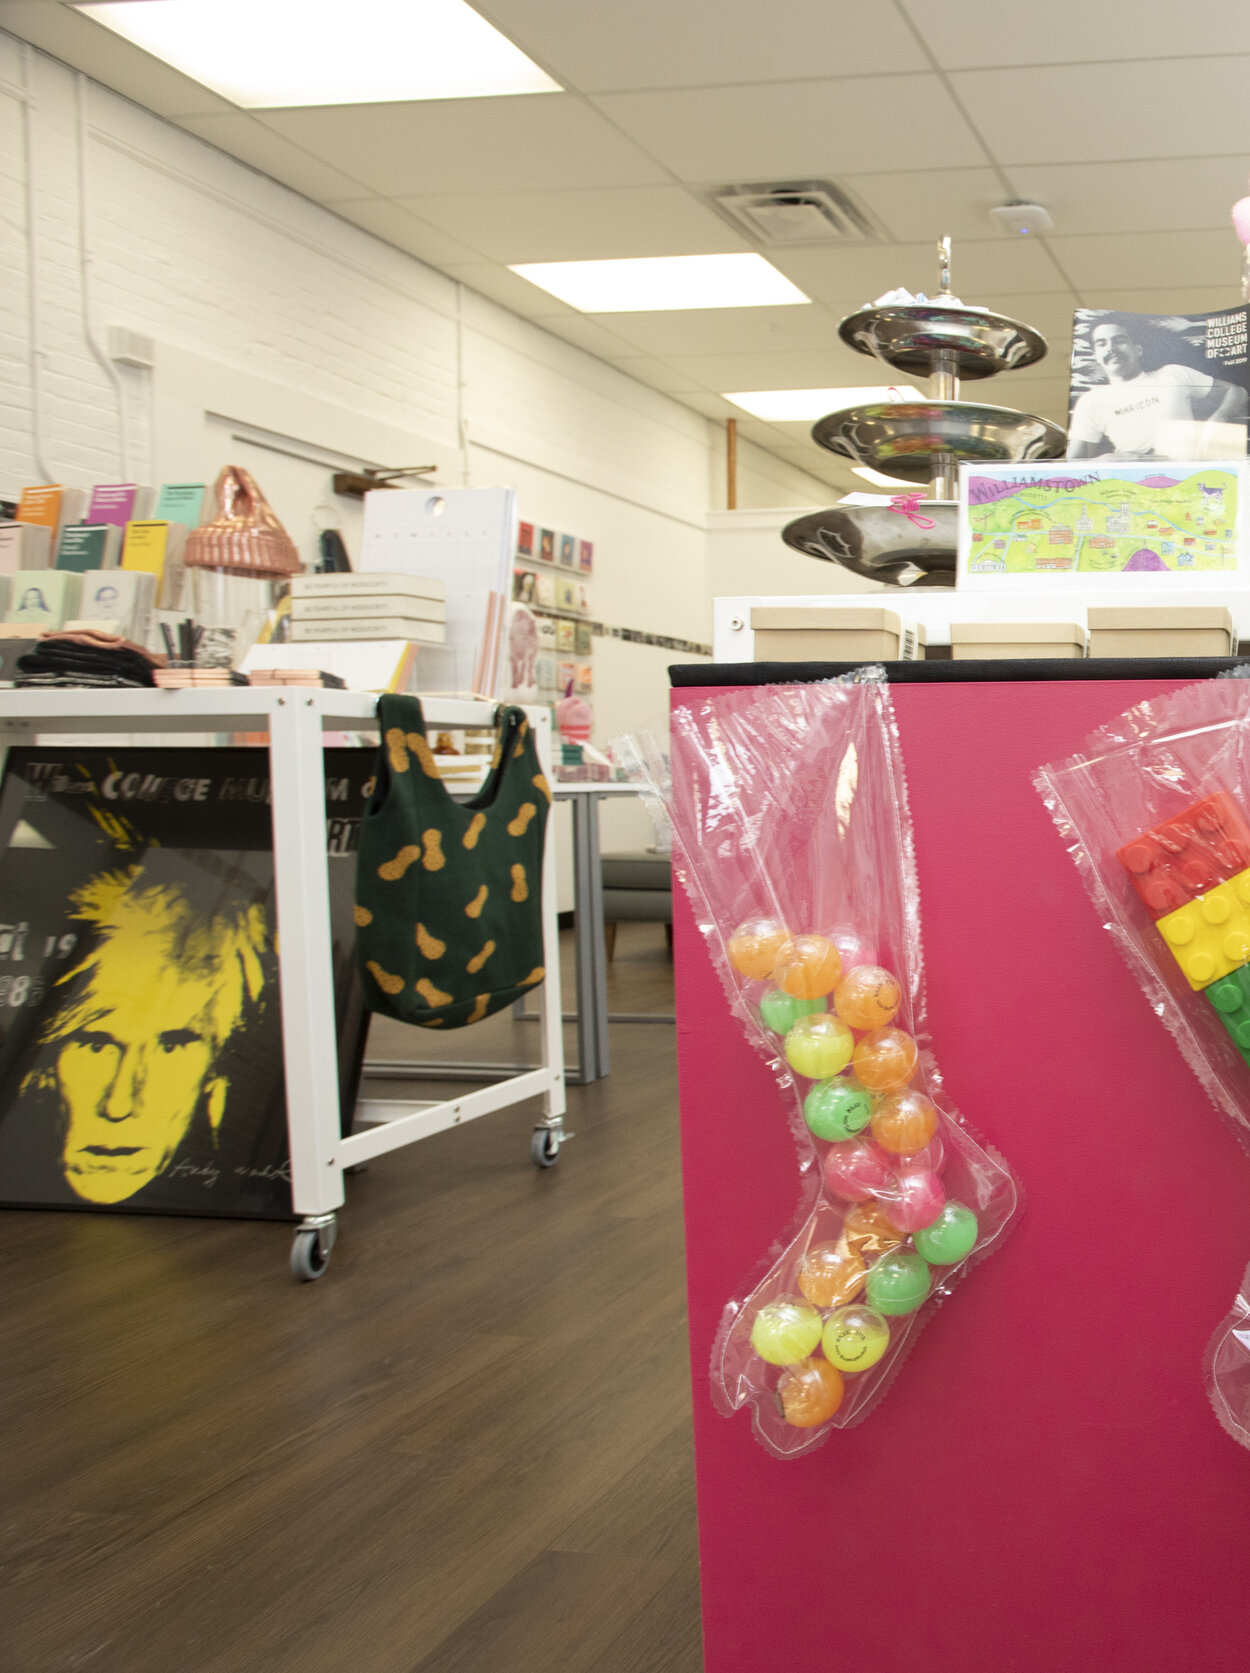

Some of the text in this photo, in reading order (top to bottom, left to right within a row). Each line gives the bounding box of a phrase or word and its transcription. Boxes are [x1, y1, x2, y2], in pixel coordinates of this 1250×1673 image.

[1206, 311, 1248, 328] WILLIAMS
[1206, 321, 1248, 339] COLLEGE
[1206, 332, 1248, 349] MUSEUM
[1231, 343, 1248, 356] ART
[969, 471, 1101, 502] WILLIAMSTOWN
